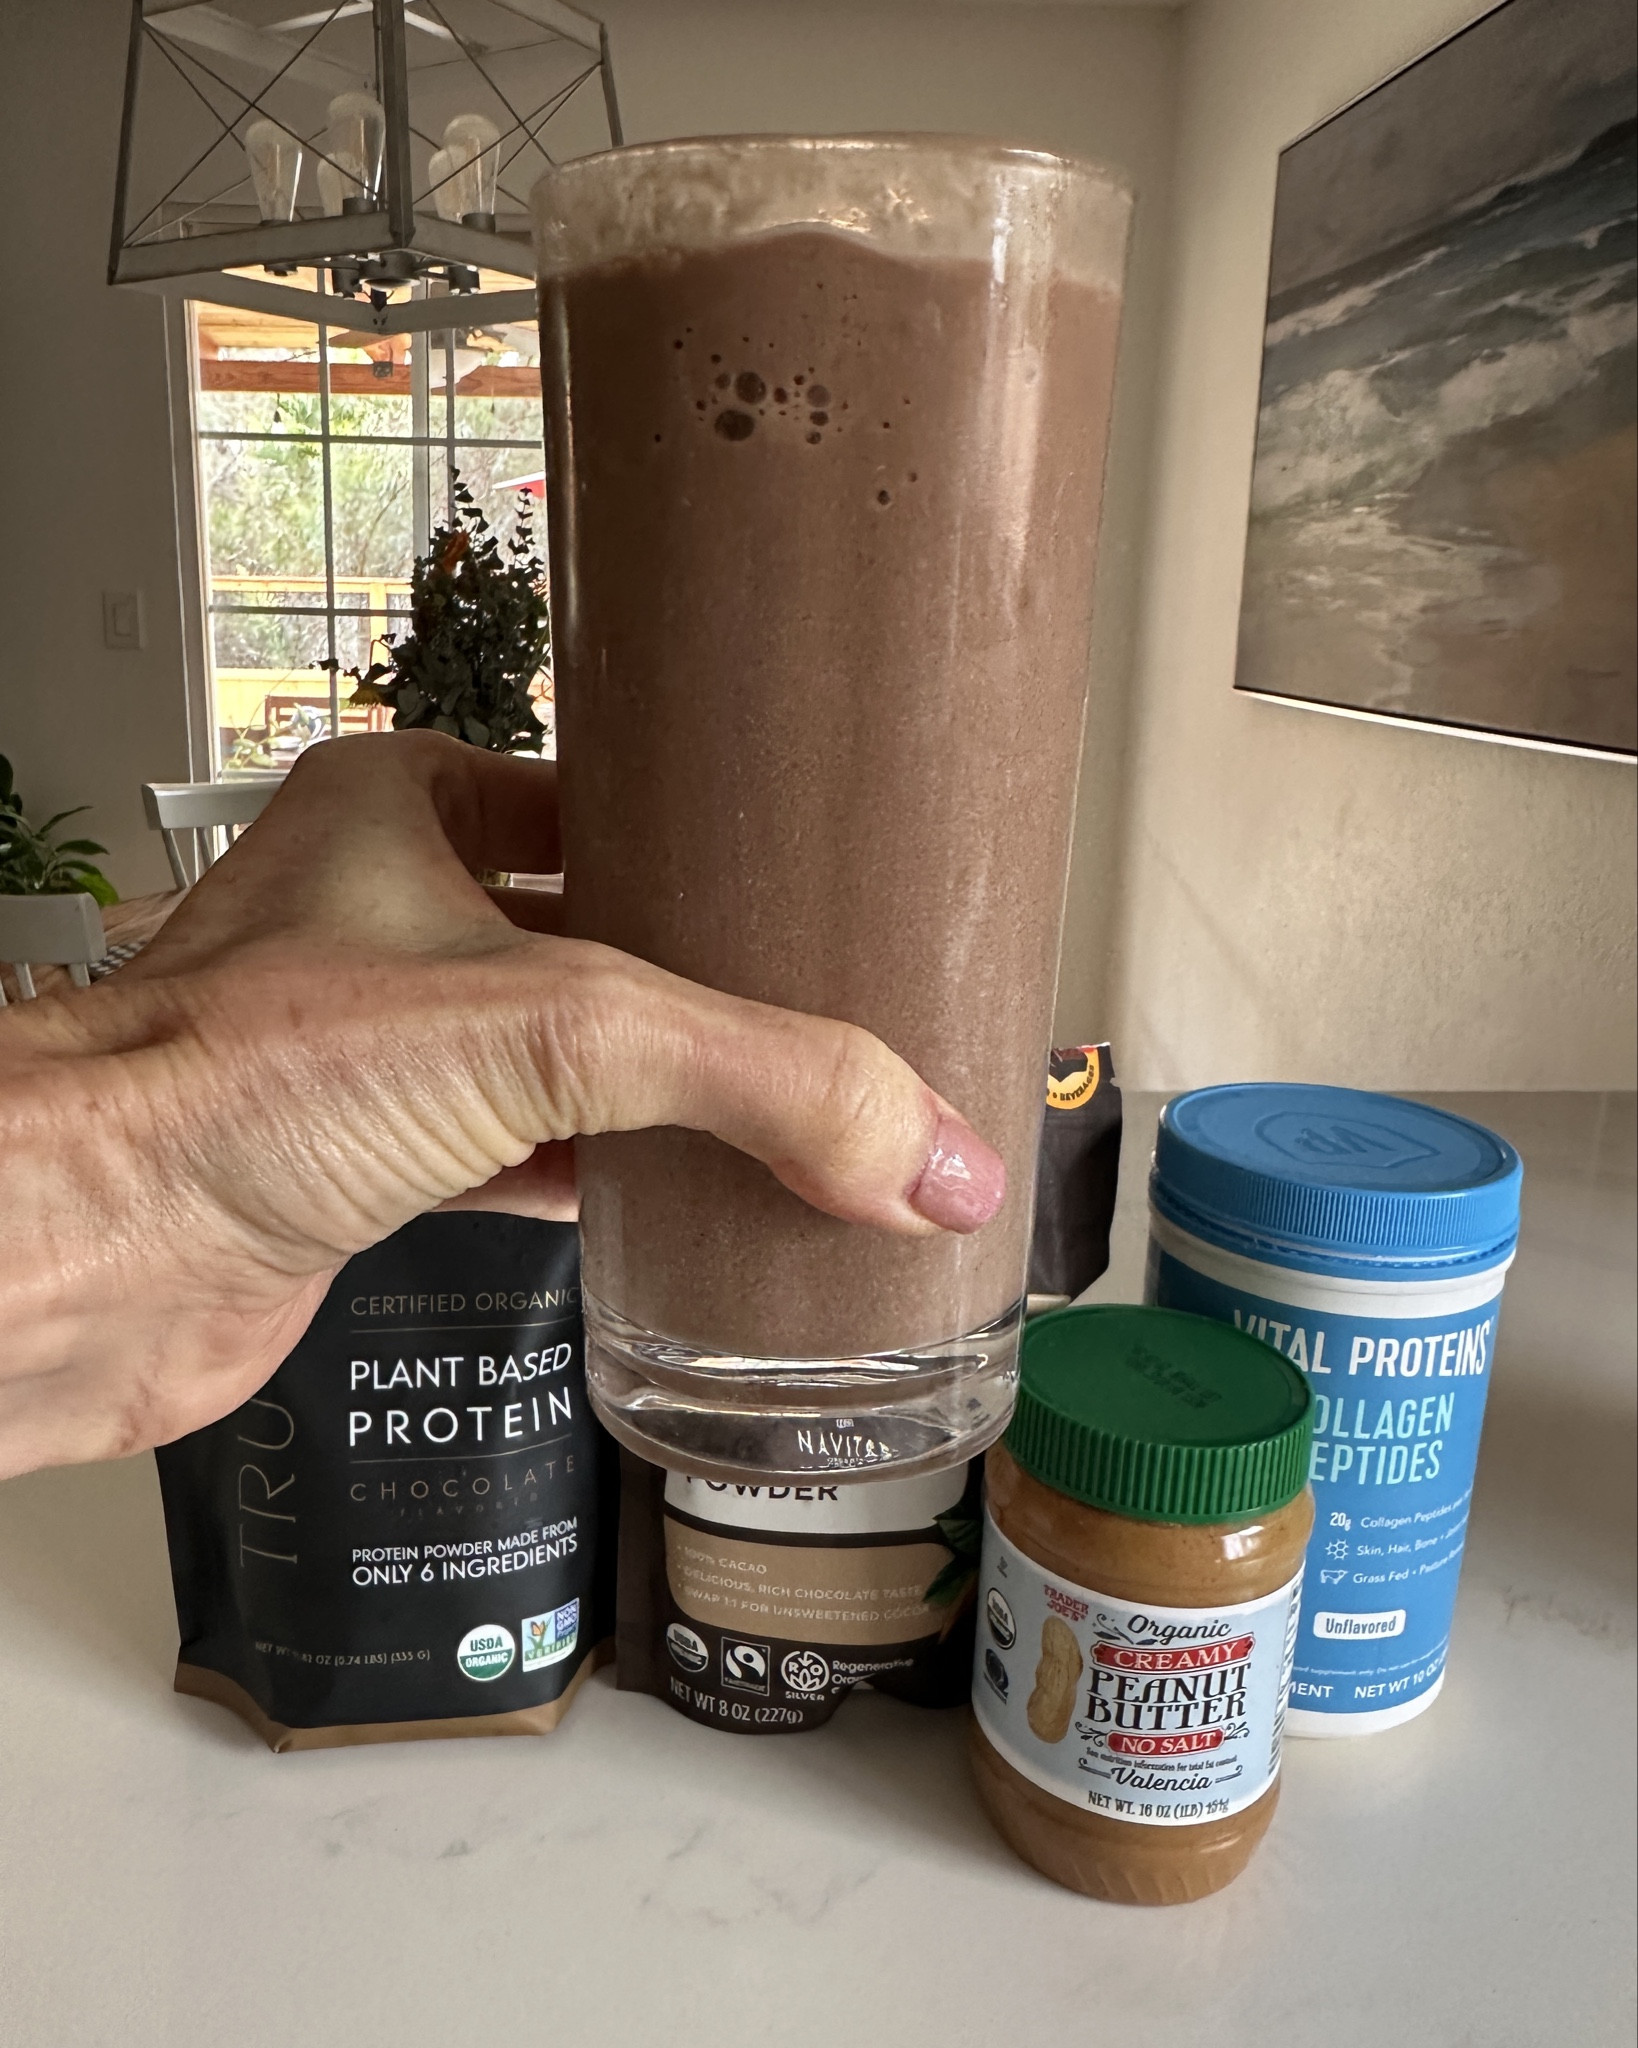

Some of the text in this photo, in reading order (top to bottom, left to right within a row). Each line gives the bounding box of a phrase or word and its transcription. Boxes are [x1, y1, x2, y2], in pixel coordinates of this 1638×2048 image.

[351, 1287, 578, 1316] CERTIFIED ORGANIC
[1234, 1309, 1489, 1377] VITAL PROTEINS
[350, 1343, 572, 1390] PLANT BASED
[350, 1386, 573, 1446] PROTEIN
[1313, 1392, 1455, 1439] OLLAGEN
[1308, 1440, 1443, 1485] EPTIDES
[350, 1454, 576, 1501] CHOCOLATE
[1330, 1512, 1351, 1531] 20g
[1360, 1516, 1412, 1530] Collagen
[352, 1517, 577, 1563] PROTEIN POWDER MADE FROM
[1356, 1545, 1384, 1556] Skin,
[352, 1534, 577, 1586] ONLY 6 INGREDIENTS
[718, 1558, 767, 1575] CACAO
[1352, 1572, 1385, 1584] Grass
[1388, 1568, 1409, 1582] Fed
[758, 1584, 790, 1598] RICH
[794, 1588, 878, 1601] CHOCOLATE
[1044, 1584, 1089, 1615] TRADER
[740, 1601, 769, 1614] FOR
[773, 1605, 880, 1622] UNSWEETENED
[1325, 1616, 1397, 1634] Unflavored
[470, 1636, 503, 1652] USDA
[1127, 1614, 1231, 1645] Organic
[465, 1652, 509, 1667] ORGANIC
[1114, 1642, 1238, 1670] CREAMY
[1086, 1663, 1251, 1702] PEANUT
[1354, 1683, 1386, 1698] NET
[1388, 1676, 1410, 1694] WT
[1413, 1670, 1425, 1686] 10
[670, 1676, 804, 1724] NET WT 8 OZ (227g)
[1084, 1690, 1248, 1731] BUTTER
[1120, 1733, 1216, 1754] NO SALT
[1110, 1767, 1213, 1791] Valencia
[1088, 1790, 1112, 1809] NET
[1140, 1803, 1152, 1817] 16
[1156, 1804, 1171, 1818] OZ
[1174, 1802, 1203, 1819] (1LB)
